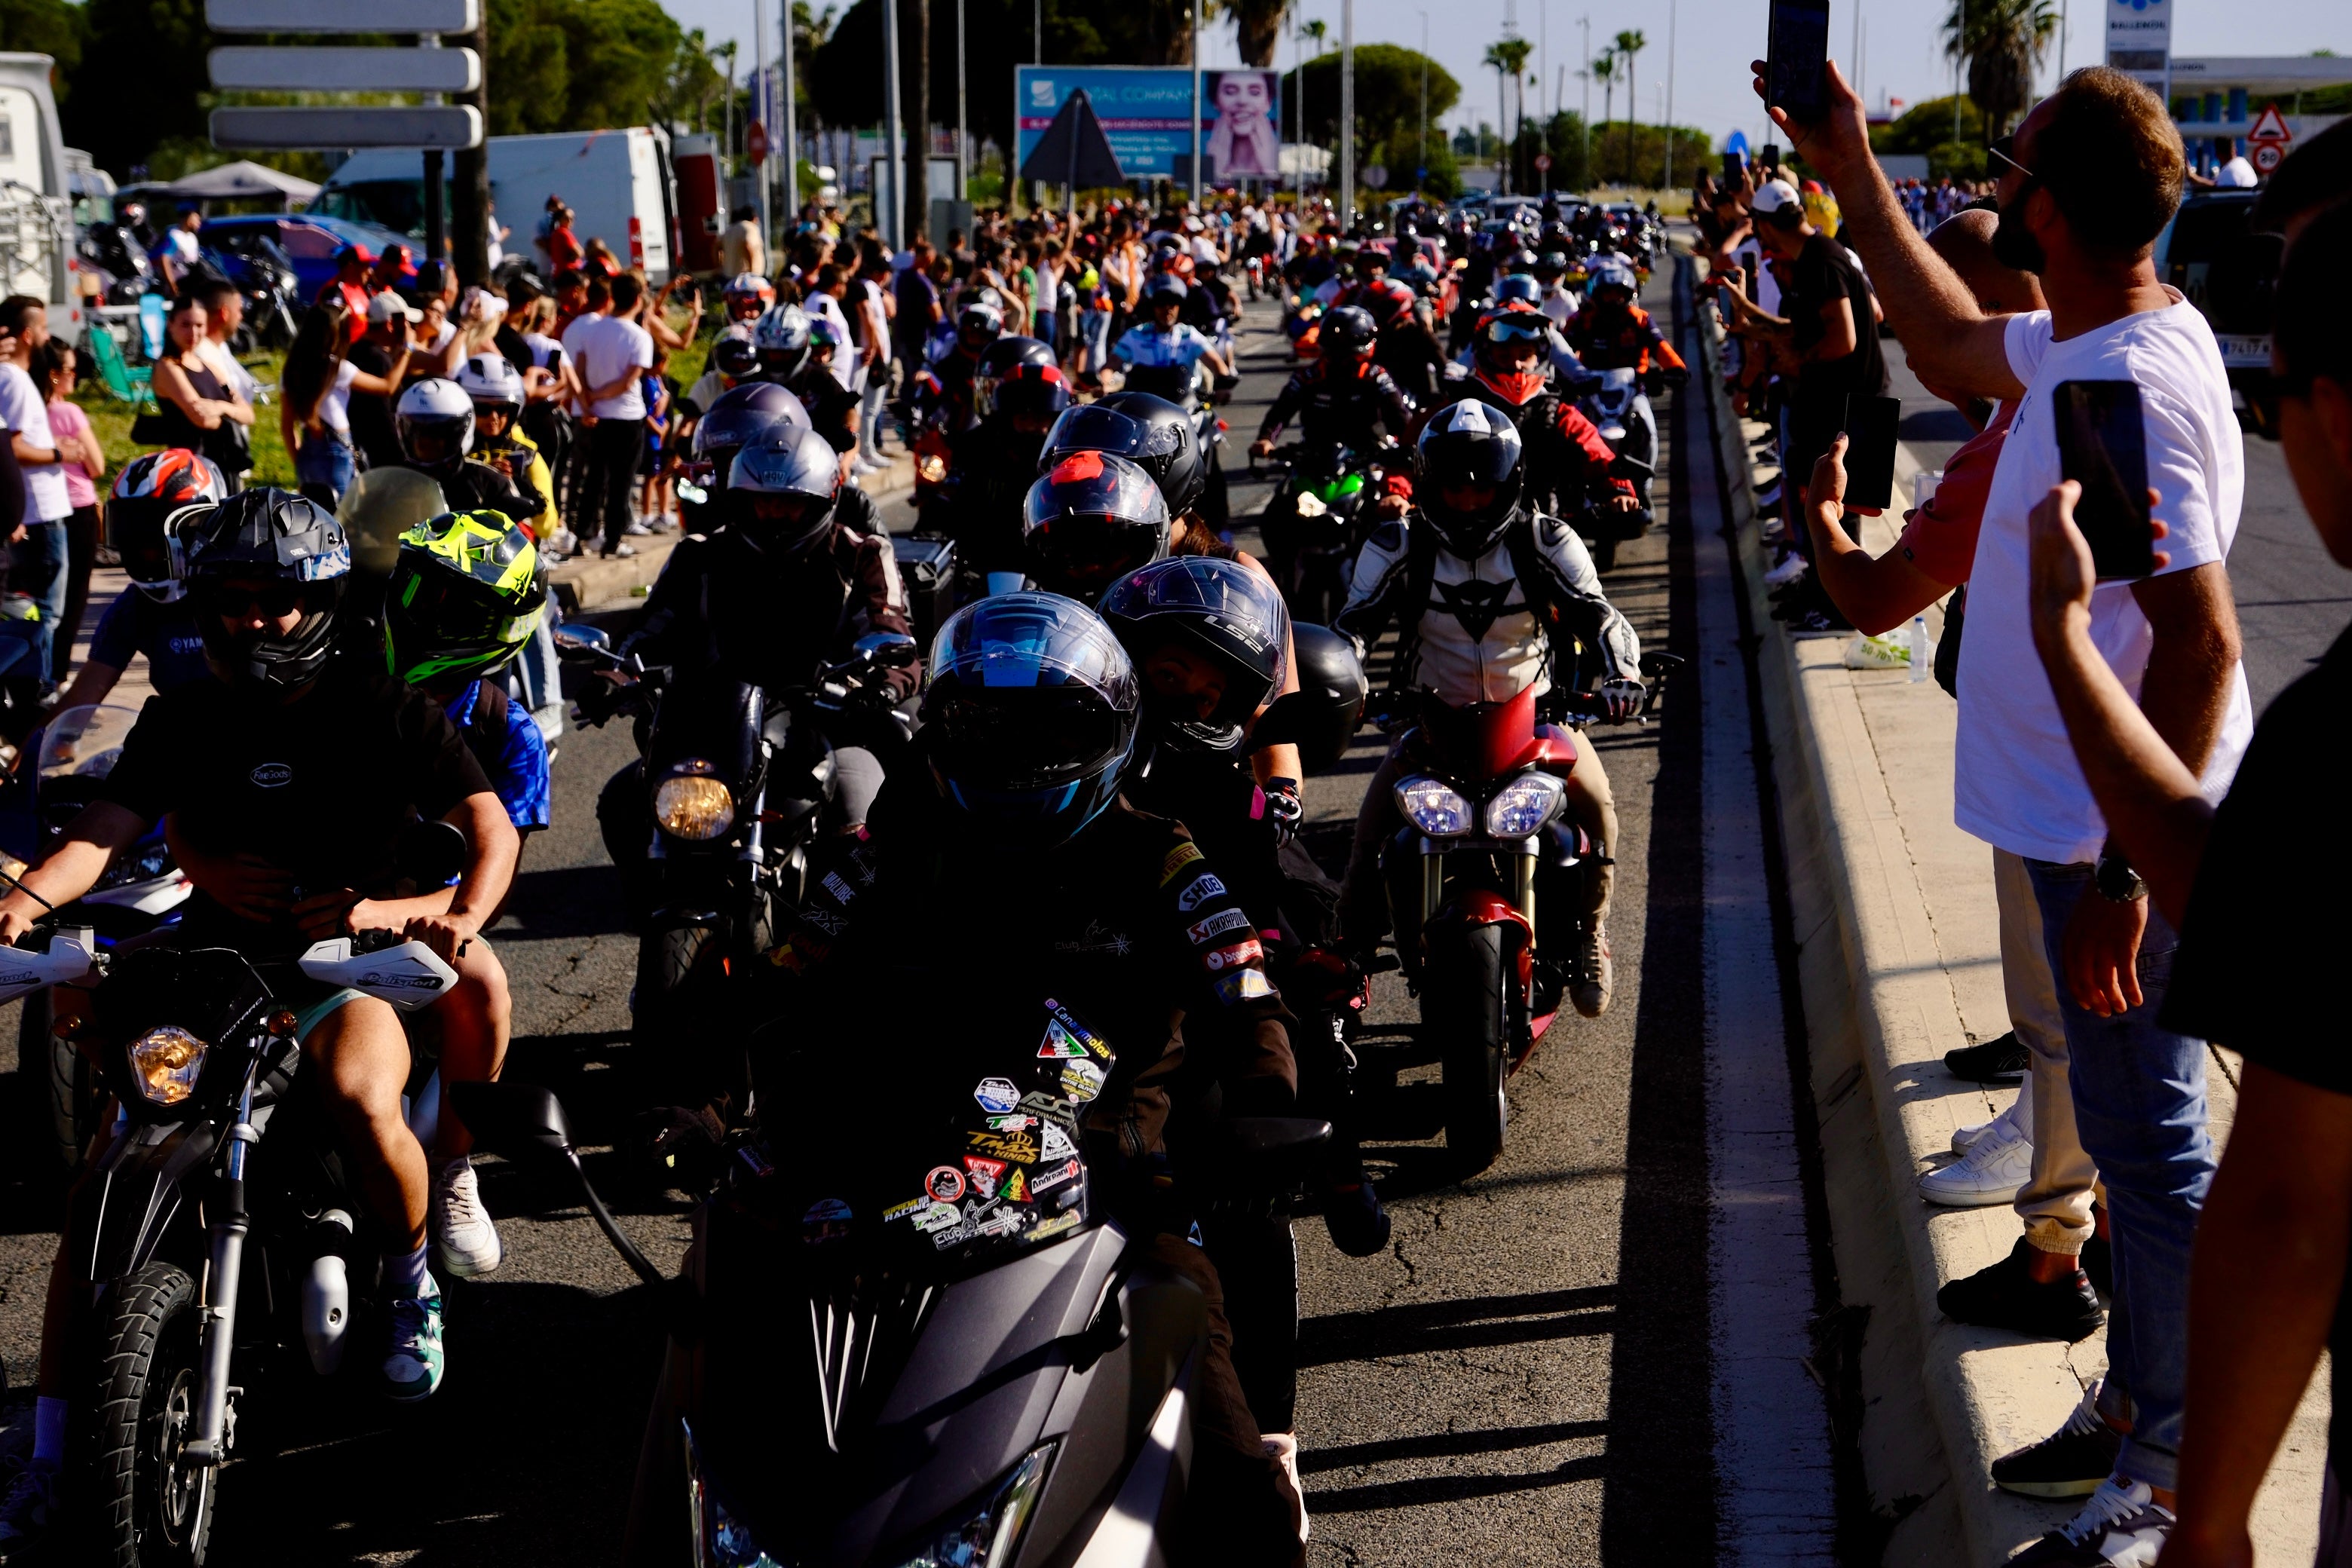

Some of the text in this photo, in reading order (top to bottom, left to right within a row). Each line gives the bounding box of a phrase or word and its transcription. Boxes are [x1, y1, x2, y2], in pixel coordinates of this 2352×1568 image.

[1203, 614, 1264, 656] LS2
[1182, 876, 1223, 910] SHOEI
[1223, 945, 1262, 963] brembo
[363, 972, 437, 988] Polisport
[219, 996, 263, 1043] MOTARD
[1055, 1006, 1111, 1059] Canarymotos
[1059, 1076, 1078, 1088] ENTRE
[1077, 1084, 1098, 1095] OLIVOS
[1018, 1104, 1072, 1128] PERFORMANCE
[967, 1131, 1040, 1158] TMAX
[993, 1149, 1038, 1165] KINGS
[1032, 1166, 1069, 1190] Andreani
[884, 1202, 931, 1223] RACING
[936, 1228, 964, 1245] Club
